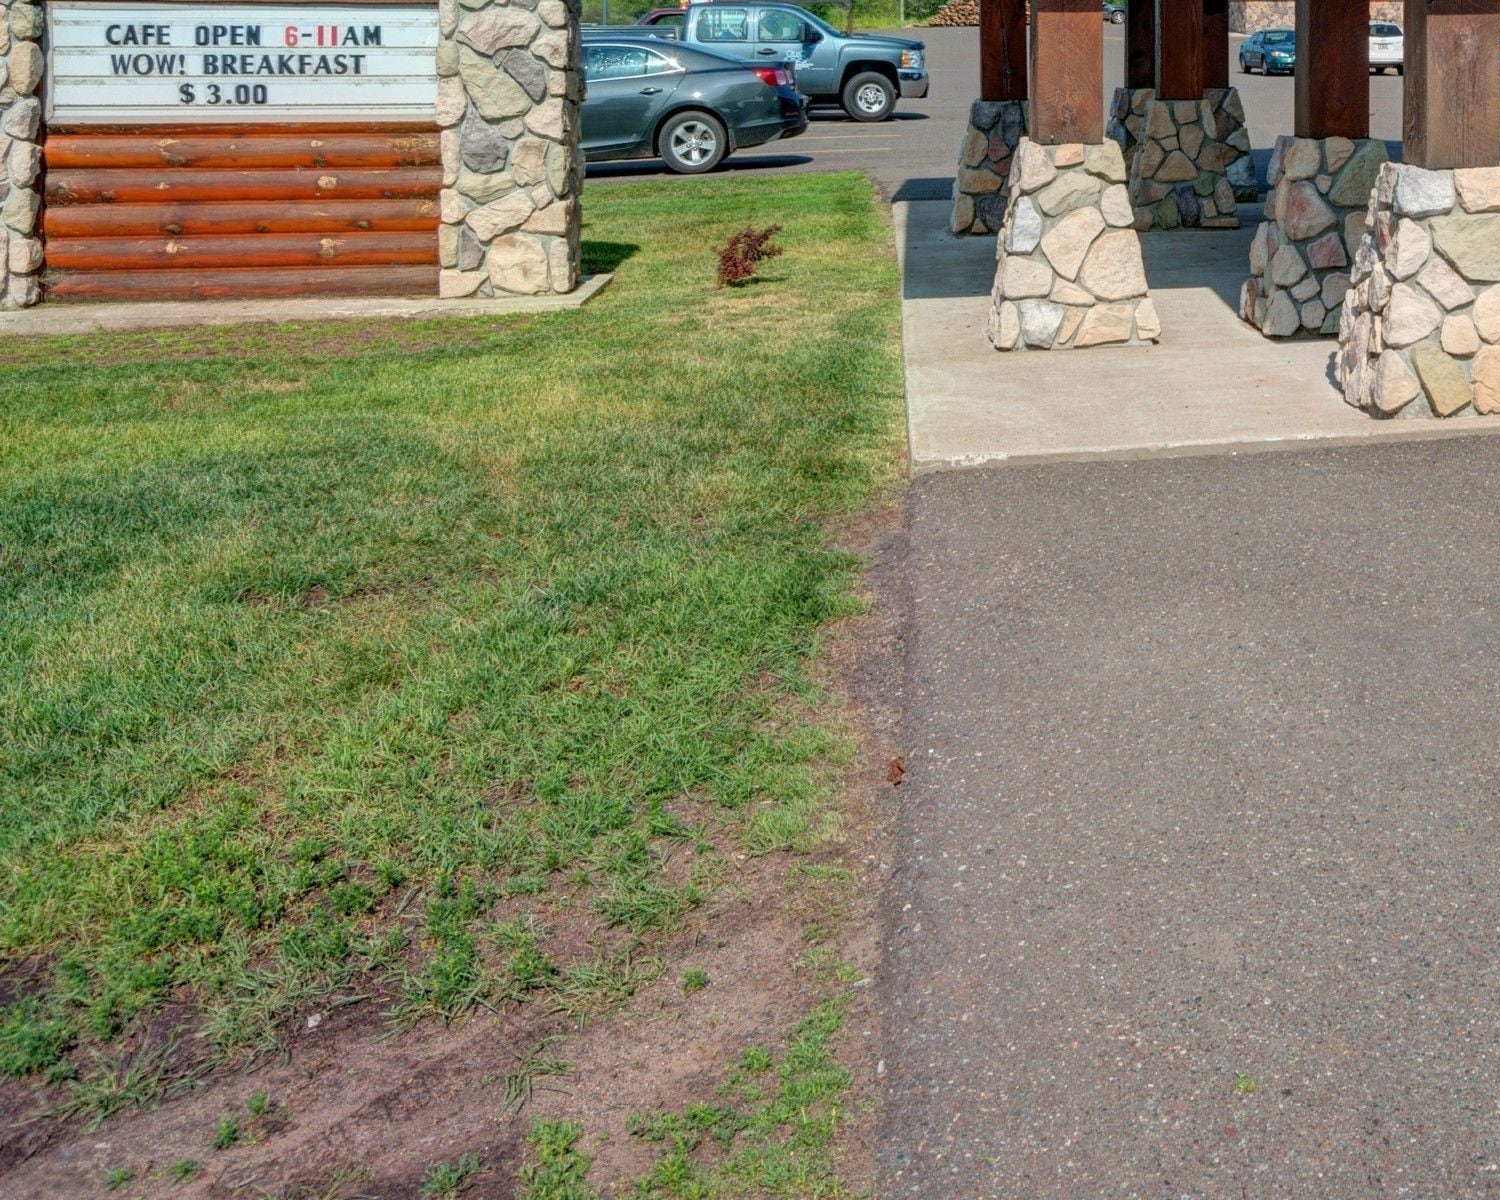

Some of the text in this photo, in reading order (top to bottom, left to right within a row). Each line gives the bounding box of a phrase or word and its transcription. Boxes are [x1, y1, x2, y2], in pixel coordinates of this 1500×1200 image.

[105, 24, 382, 47] CAFE OPEN 6-11AM
[111, 54, 366, 75] WOW! BREAKFAST
